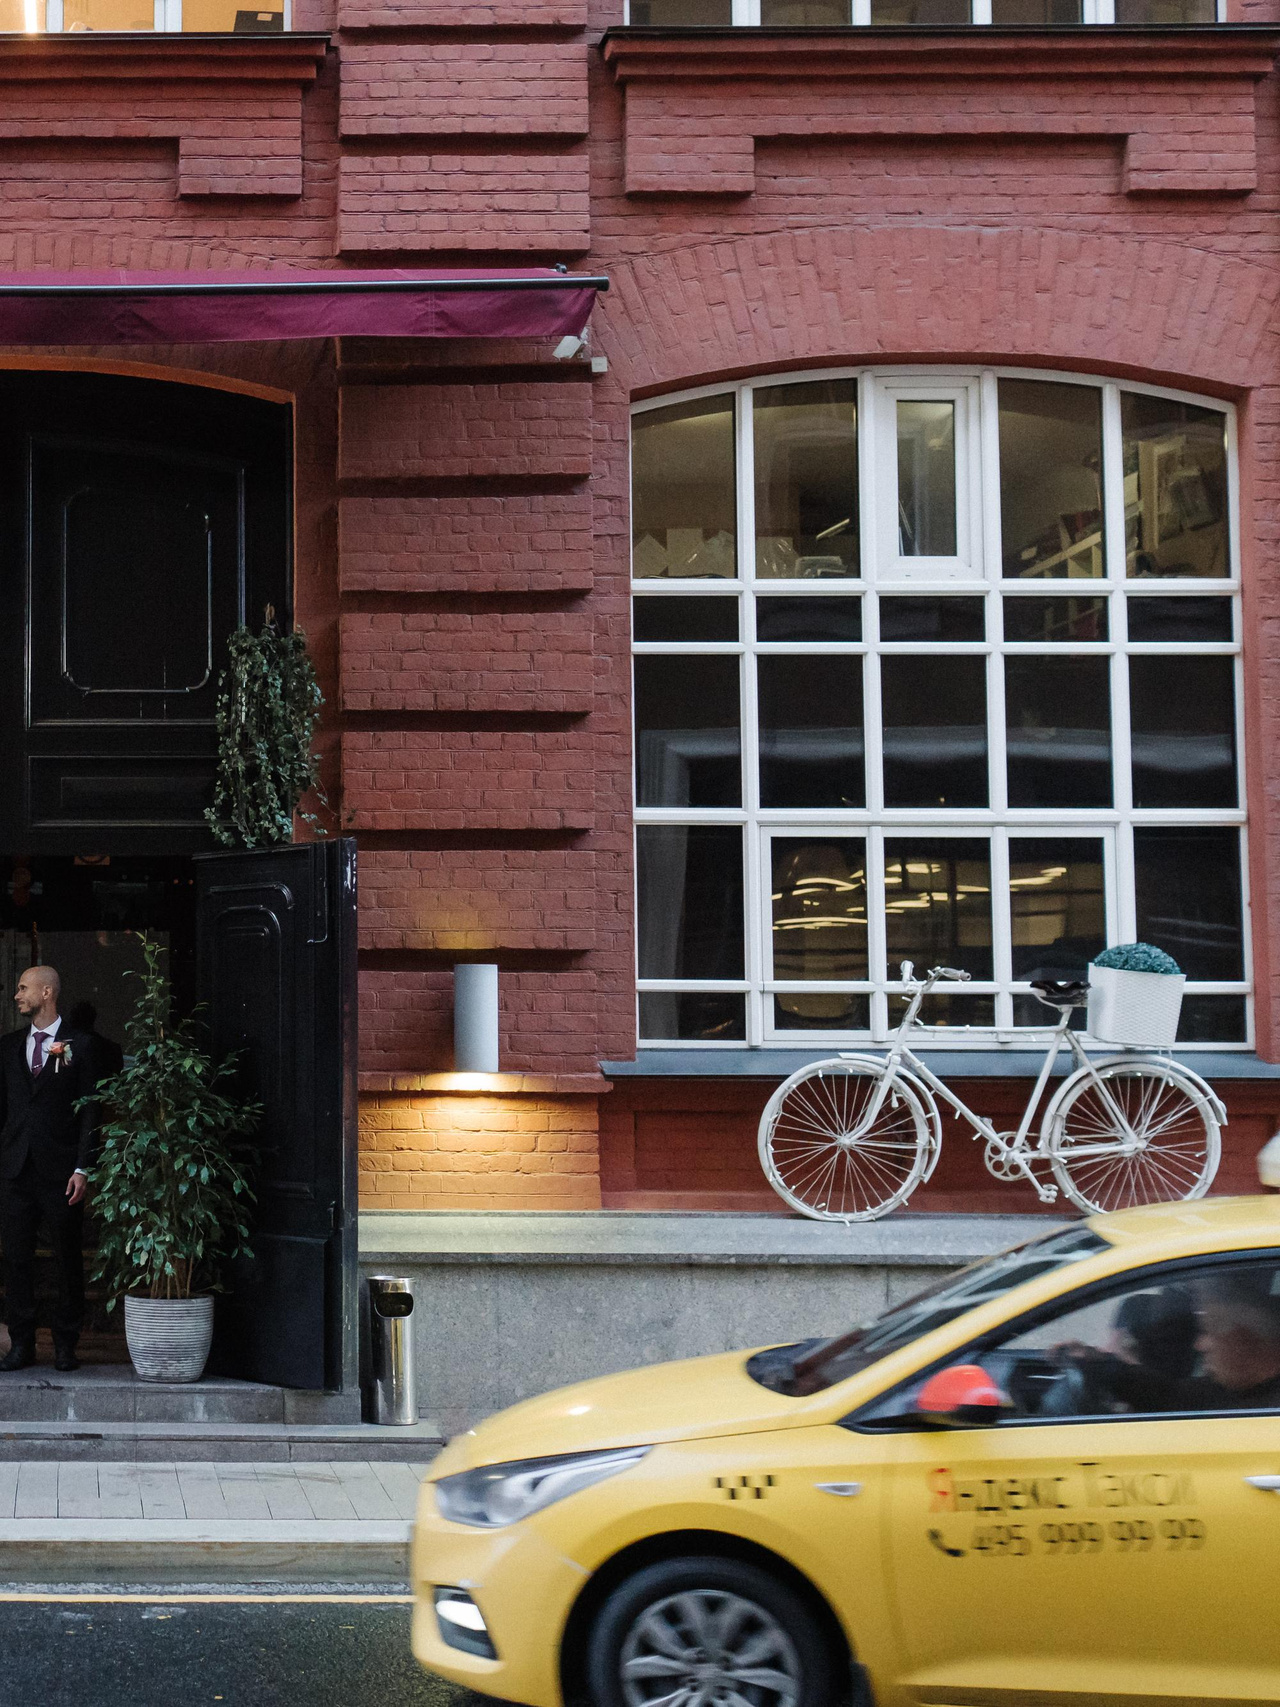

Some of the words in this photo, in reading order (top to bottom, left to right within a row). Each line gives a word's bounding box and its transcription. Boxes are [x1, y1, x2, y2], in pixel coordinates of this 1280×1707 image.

[973, 1524, 1031, 1557] 495
[1038, 1521, 1105, 1555] 999
[1108, 1519, 1155, 1553] 99
[1160, 1517, 1207, 1551] 99
